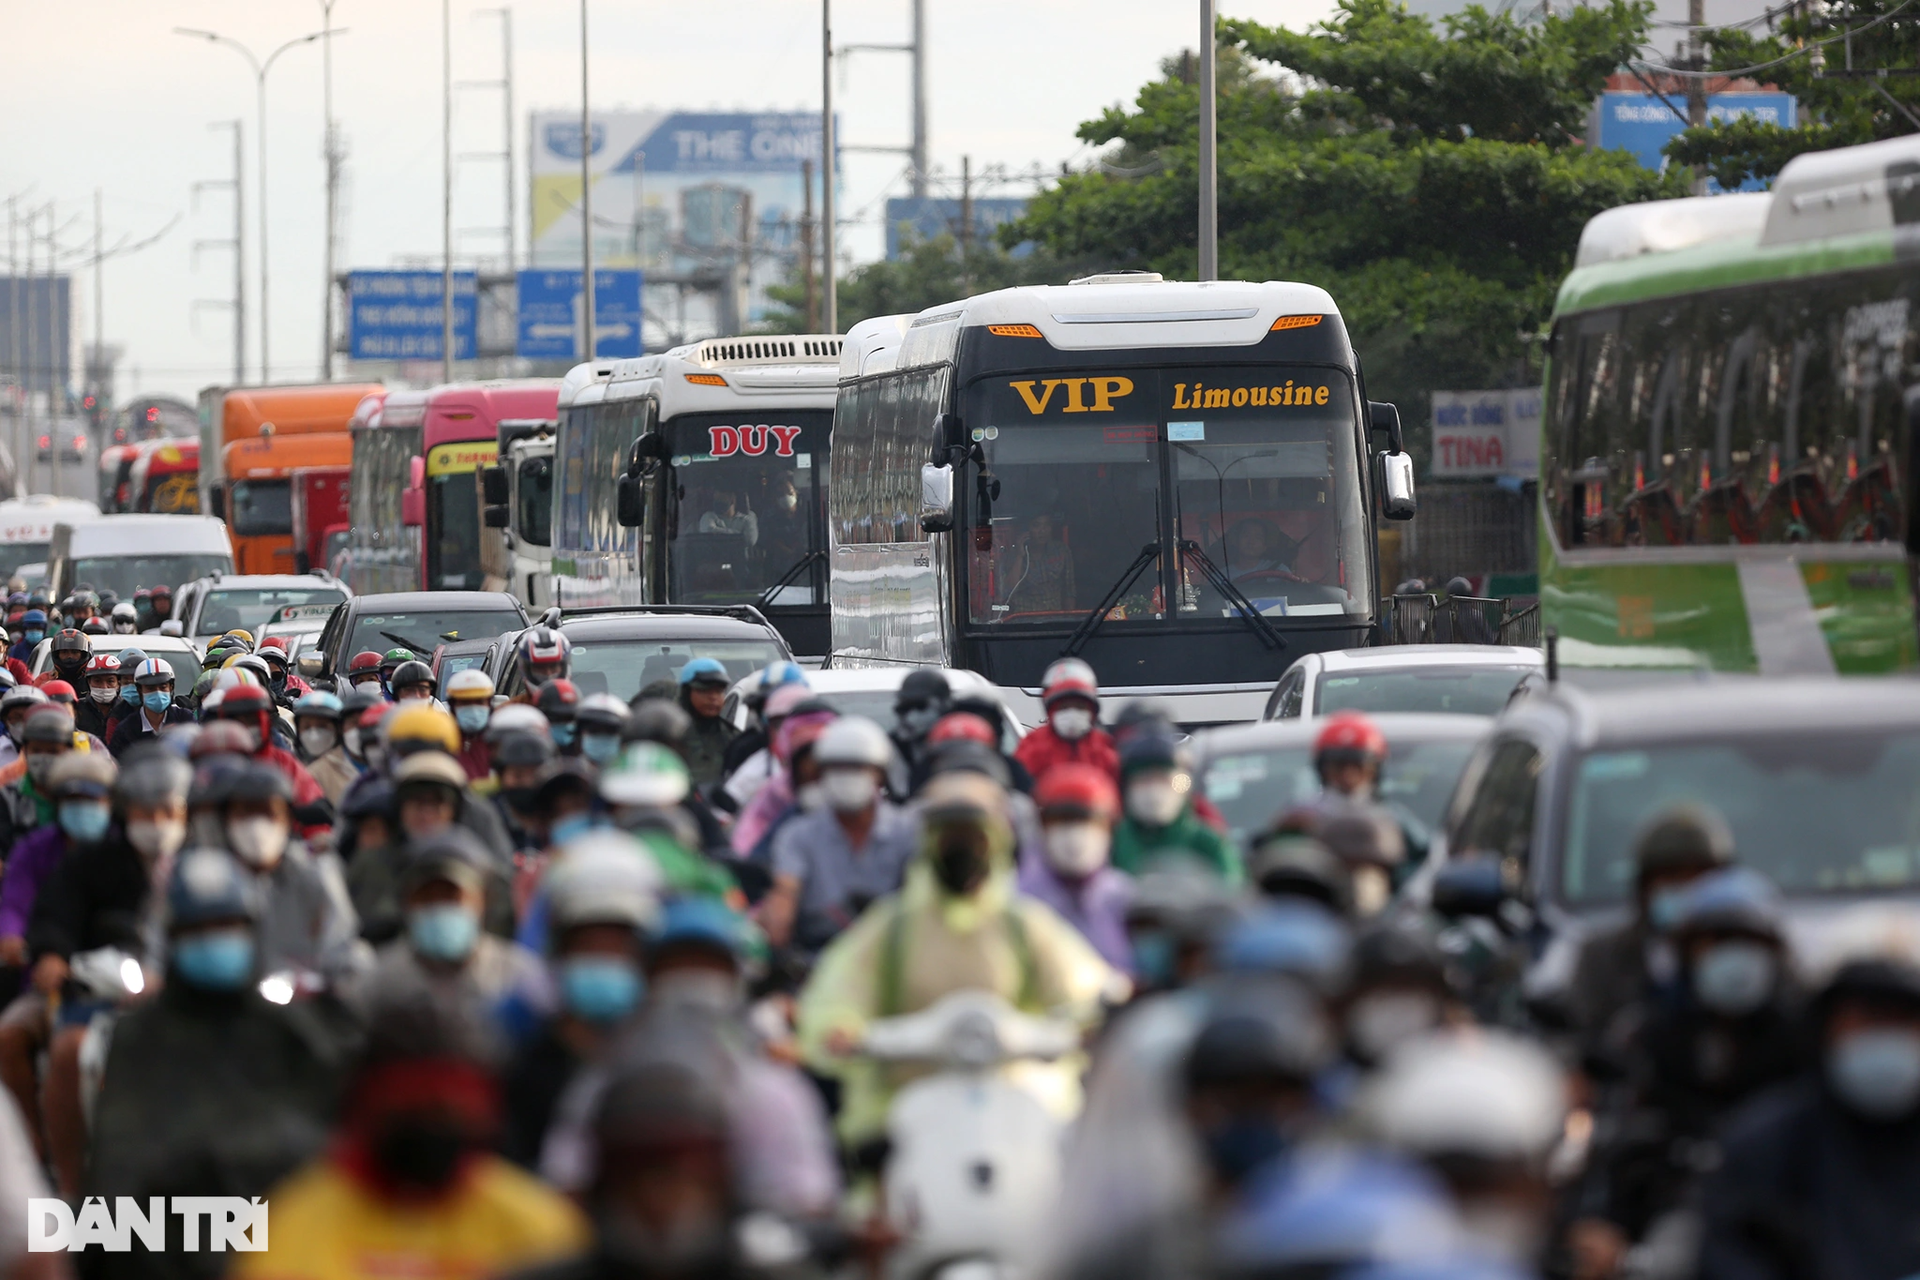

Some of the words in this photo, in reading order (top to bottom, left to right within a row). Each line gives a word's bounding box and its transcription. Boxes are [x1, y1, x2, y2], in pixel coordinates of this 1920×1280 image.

[672, 130, 745, 161] THE
[751, 130, 822, 160] ONE
[1009, 376, 1134, 415] VIP
[1172, 380, 1329, 410] Limousine
[708, 425, 801, 457] DUY
[1438, 435, 1504, 467] TINA
